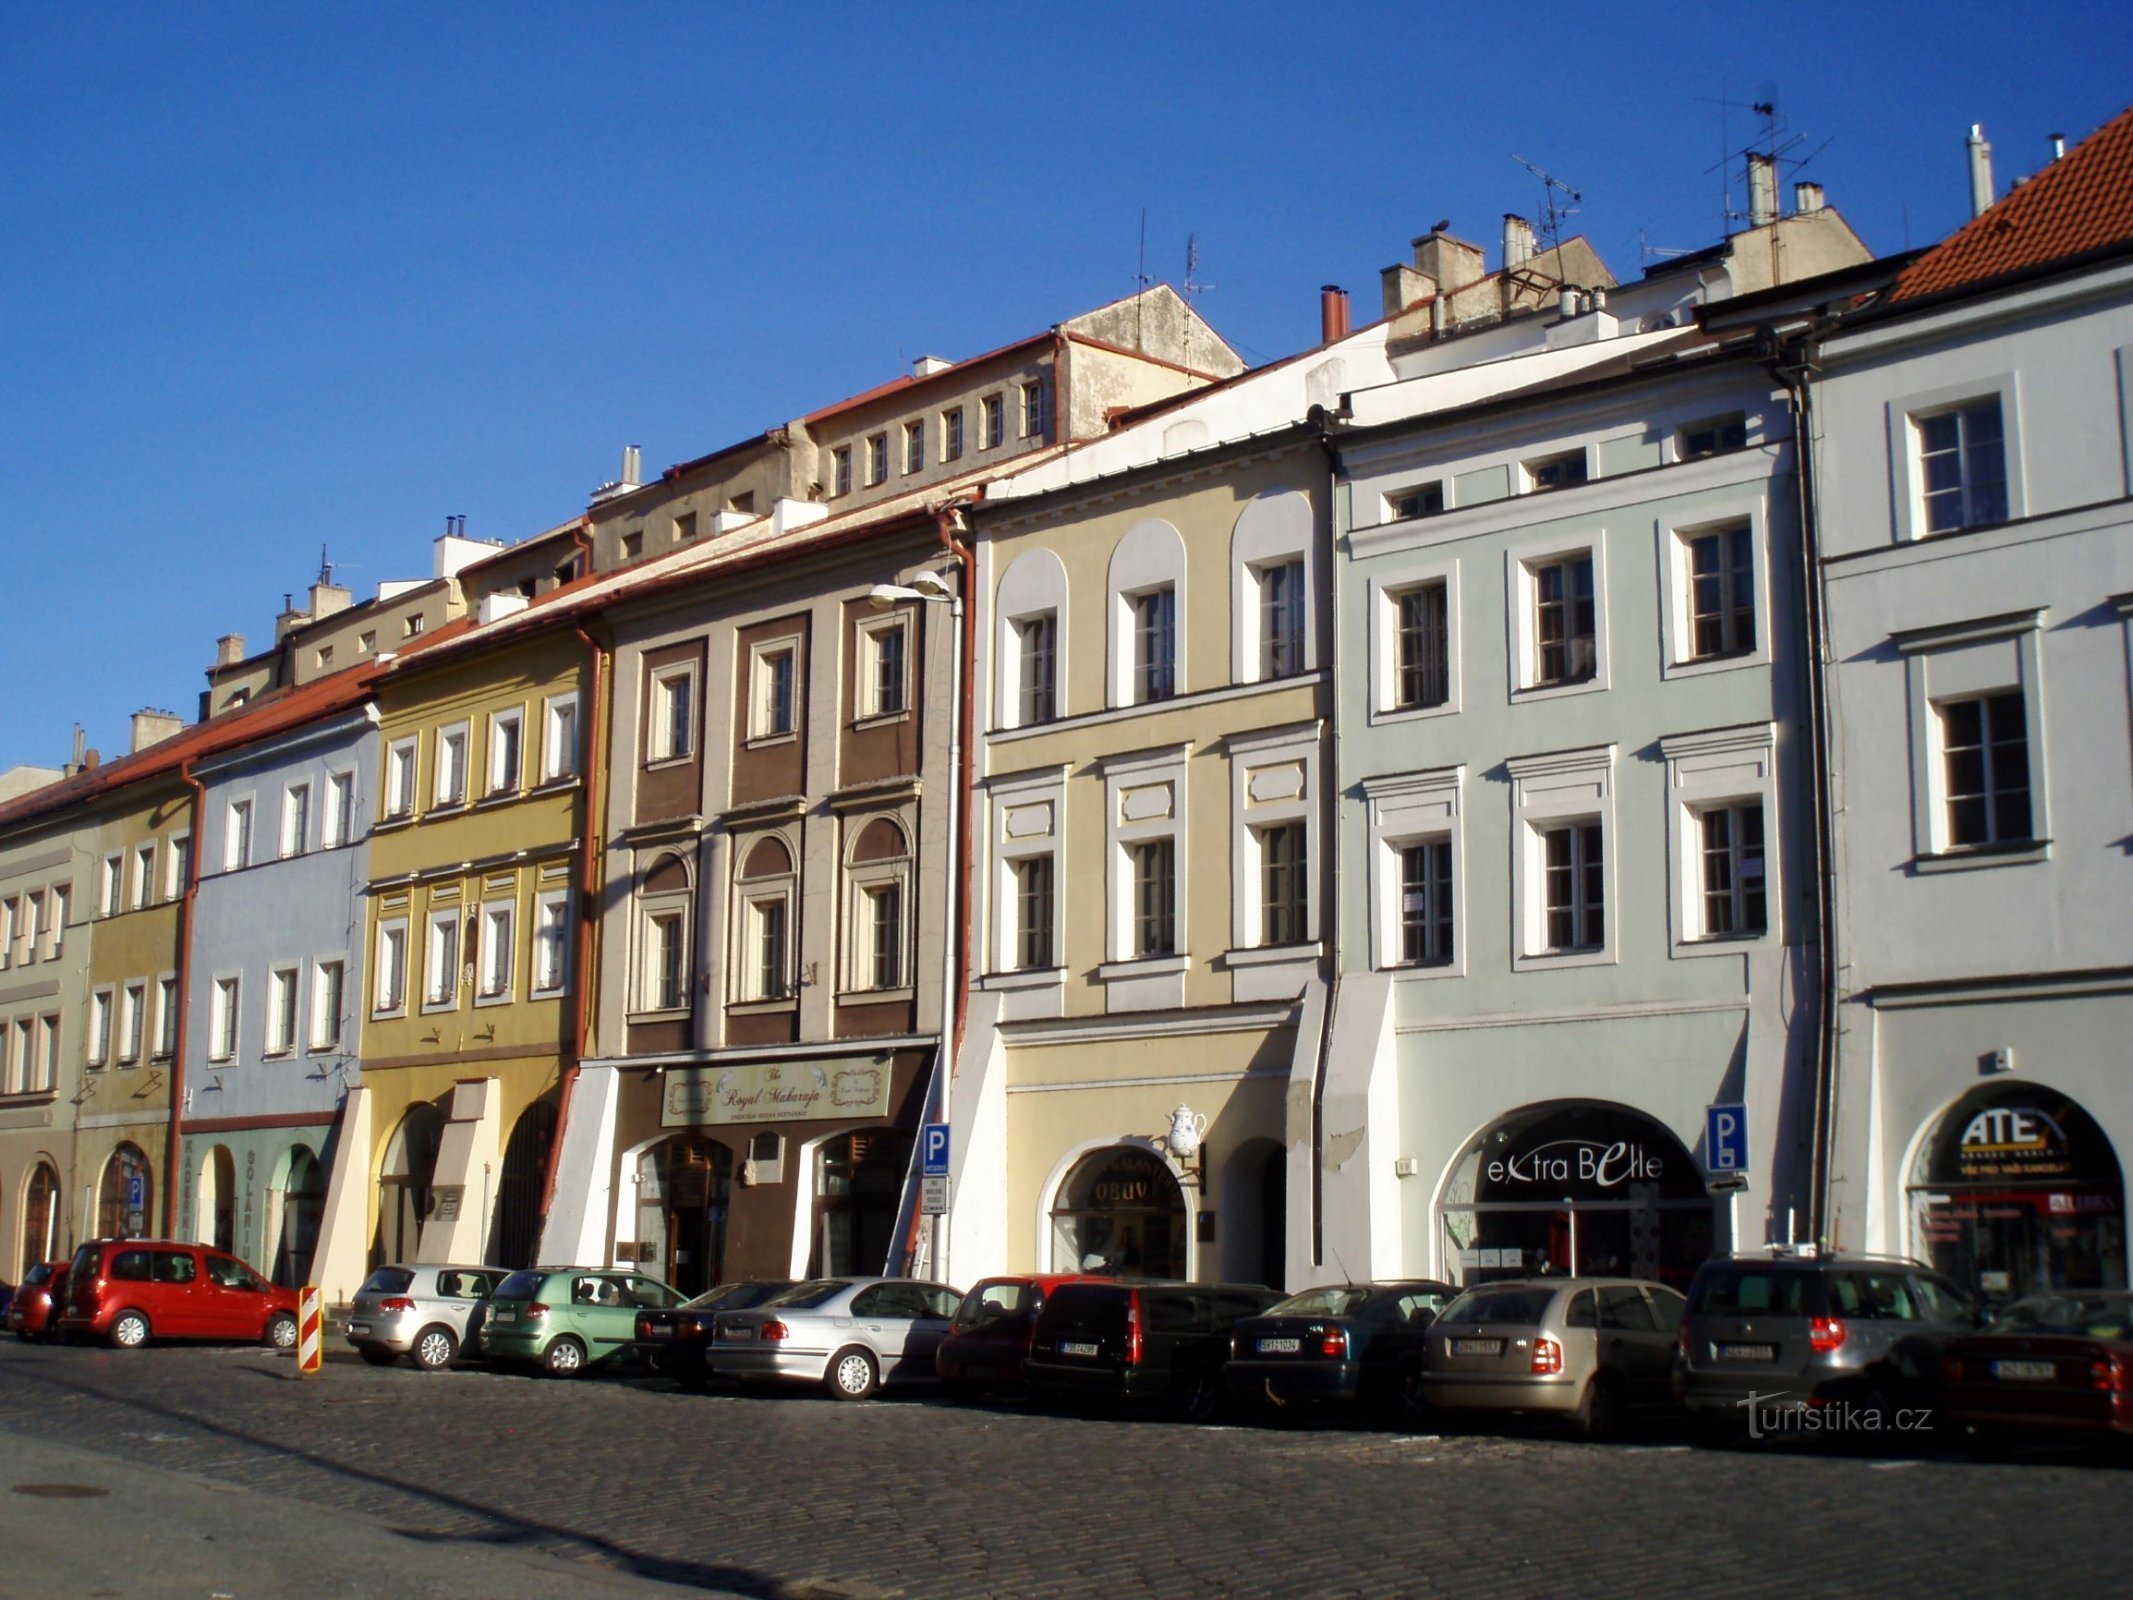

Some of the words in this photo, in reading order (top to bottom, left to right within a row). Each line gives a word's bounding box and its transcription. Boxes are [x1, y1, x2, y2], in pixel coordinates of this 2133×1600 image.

[723, 1088, 763, 1111] Royal
[764, 1087, 820, 1108] Maharaja
[1717, 1113, 1736, 1150] P
[1960, 1107, 2039, 1145] ATE
[929, 1131, 945, 1161] P
[131, 1180, 140, 1197] P
[1095, 1182, 1147, 1201] OBUV
